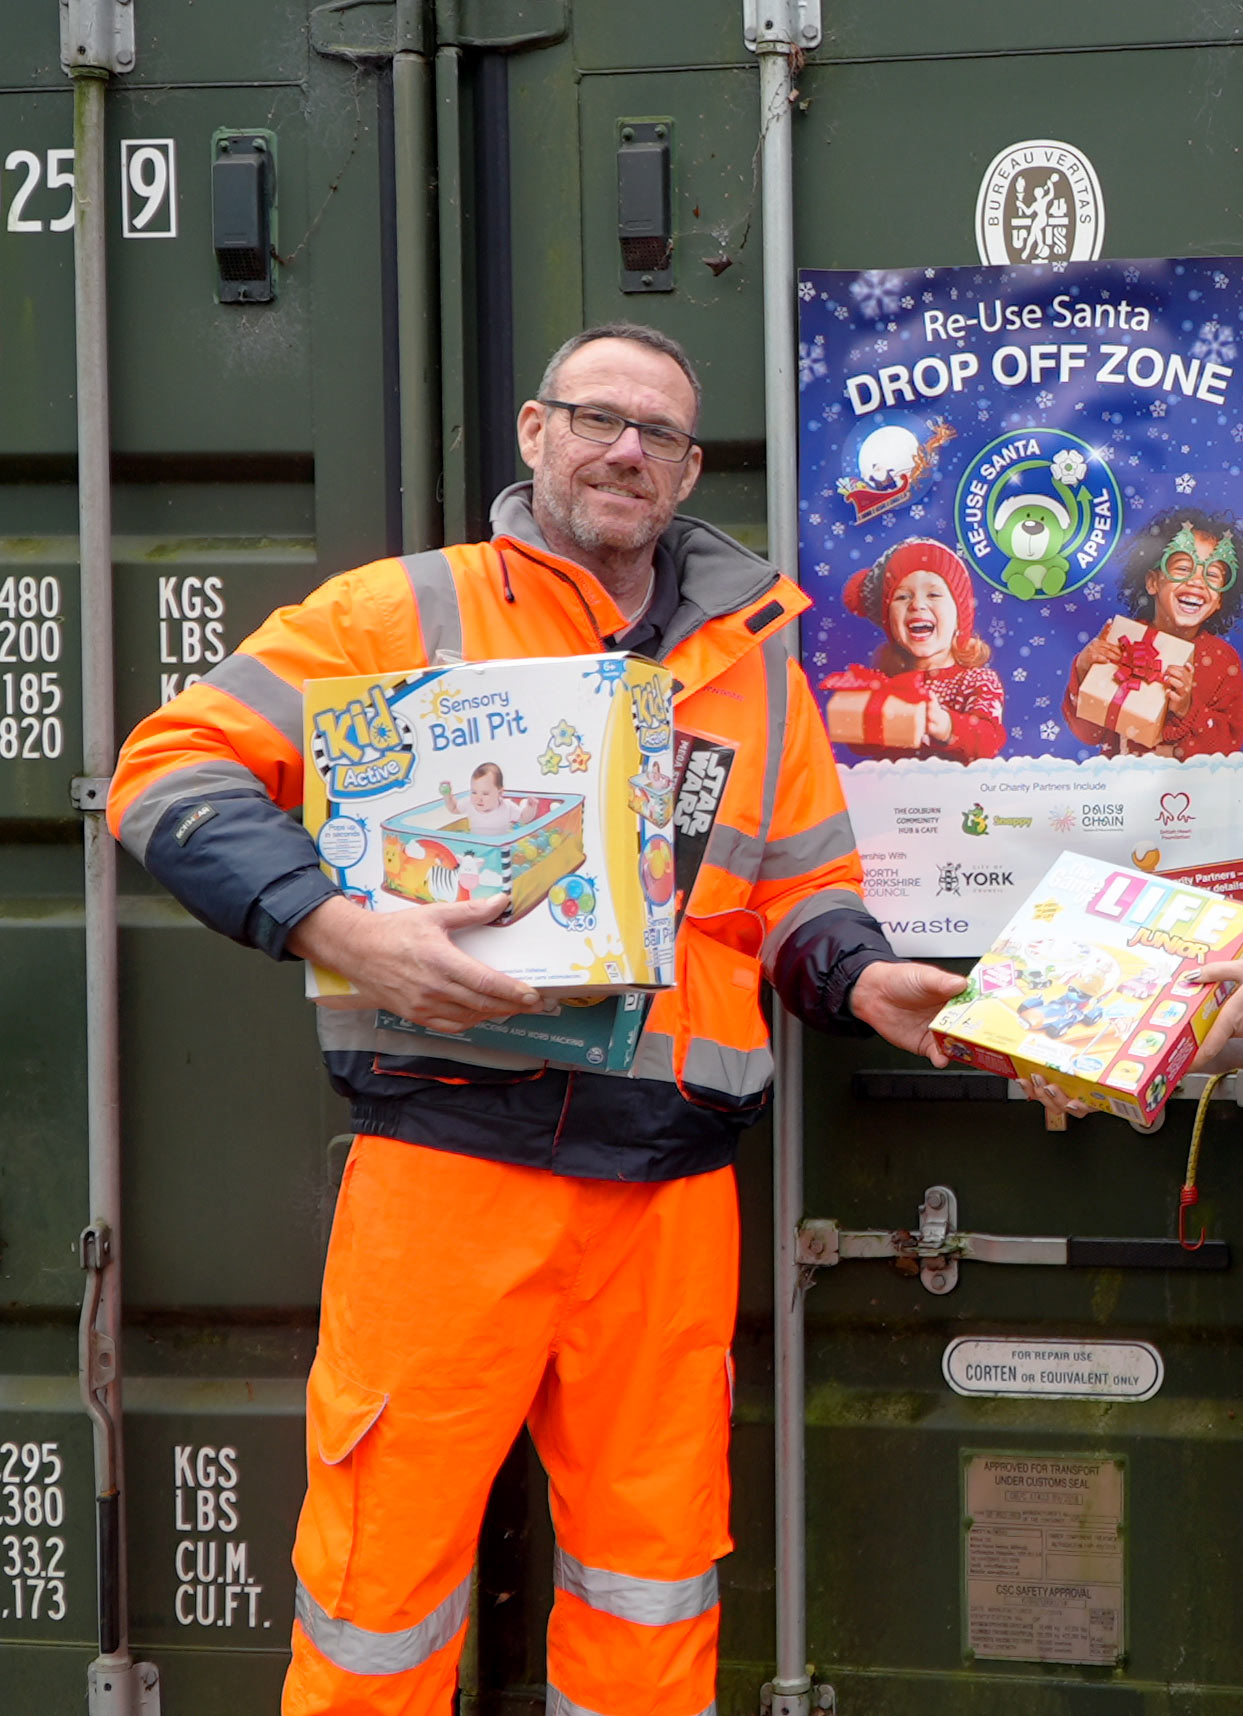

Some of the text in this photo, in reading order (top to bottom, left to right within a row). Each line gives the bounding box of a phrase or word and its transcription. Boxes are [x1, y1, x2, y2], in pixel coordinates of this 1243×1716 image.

[4, 148, 168, 233] 25 9
[988, 151, 1092, 227] BUREAU VERITAS
[924, 295, 1150, 342] Re-Use Santa
[846, 343, 1234, 416] DROP OFF ZONE
[965, 438, 1112, 569] RE-USE SANTA APPEAL
[158, 576, 224, 619] KGS
[160, 621, 225, 664] LBS
[2, 672, 62, 715] 185
[439, 691, 509, 716] Sensory
[0, 716, 62, 760] 820
[313, 684, 401, 762] Kid
[429, 709, 528, 751] Ball Pit
[343, 759, 400, 789] Active
[980, 781, 1107, 794] Our Charity Partners Include
[673, 750, 712, 838] WARS
[692, 753, 726, 834] STAR
[894, 807, 907, 815] THE
[1082, 804, 1124, 816] DAISY
[992, 814, 1033, 829] Snappy
[1082, 815, 1124, 827] CHAIN
[888, 852, 907, 860] With
[863, 878, 921, 887] YORKSHIRE
[961, 871, 1014, 886] YORK
[1195, 872, 1236, 883] Partners
[567, 914, 596, 932] x30
[1094, 875, 1239, 944] LIFE
[1127, 926, 1211, 964] JUNIOR
[1012, 1350, 1093, 1361] FOR REPAIR USE
[965, 1364, 1140, 1386] CORTEN OR EQUIVALENT ONLY
[174, 1446, 239, 1489] KGS
[984, 1462, 1100, 1476] APPROVED FOR TRANSPORT
[994, 1476, 1090, 1489] UNDER CUSTOMS SEAL
[175, 1489, 239, 1532] LBS
[3, 1535, 66, 1577] 33.2
[996, 1584, 1092, 1599] CSC SAFETY APPROVAL
